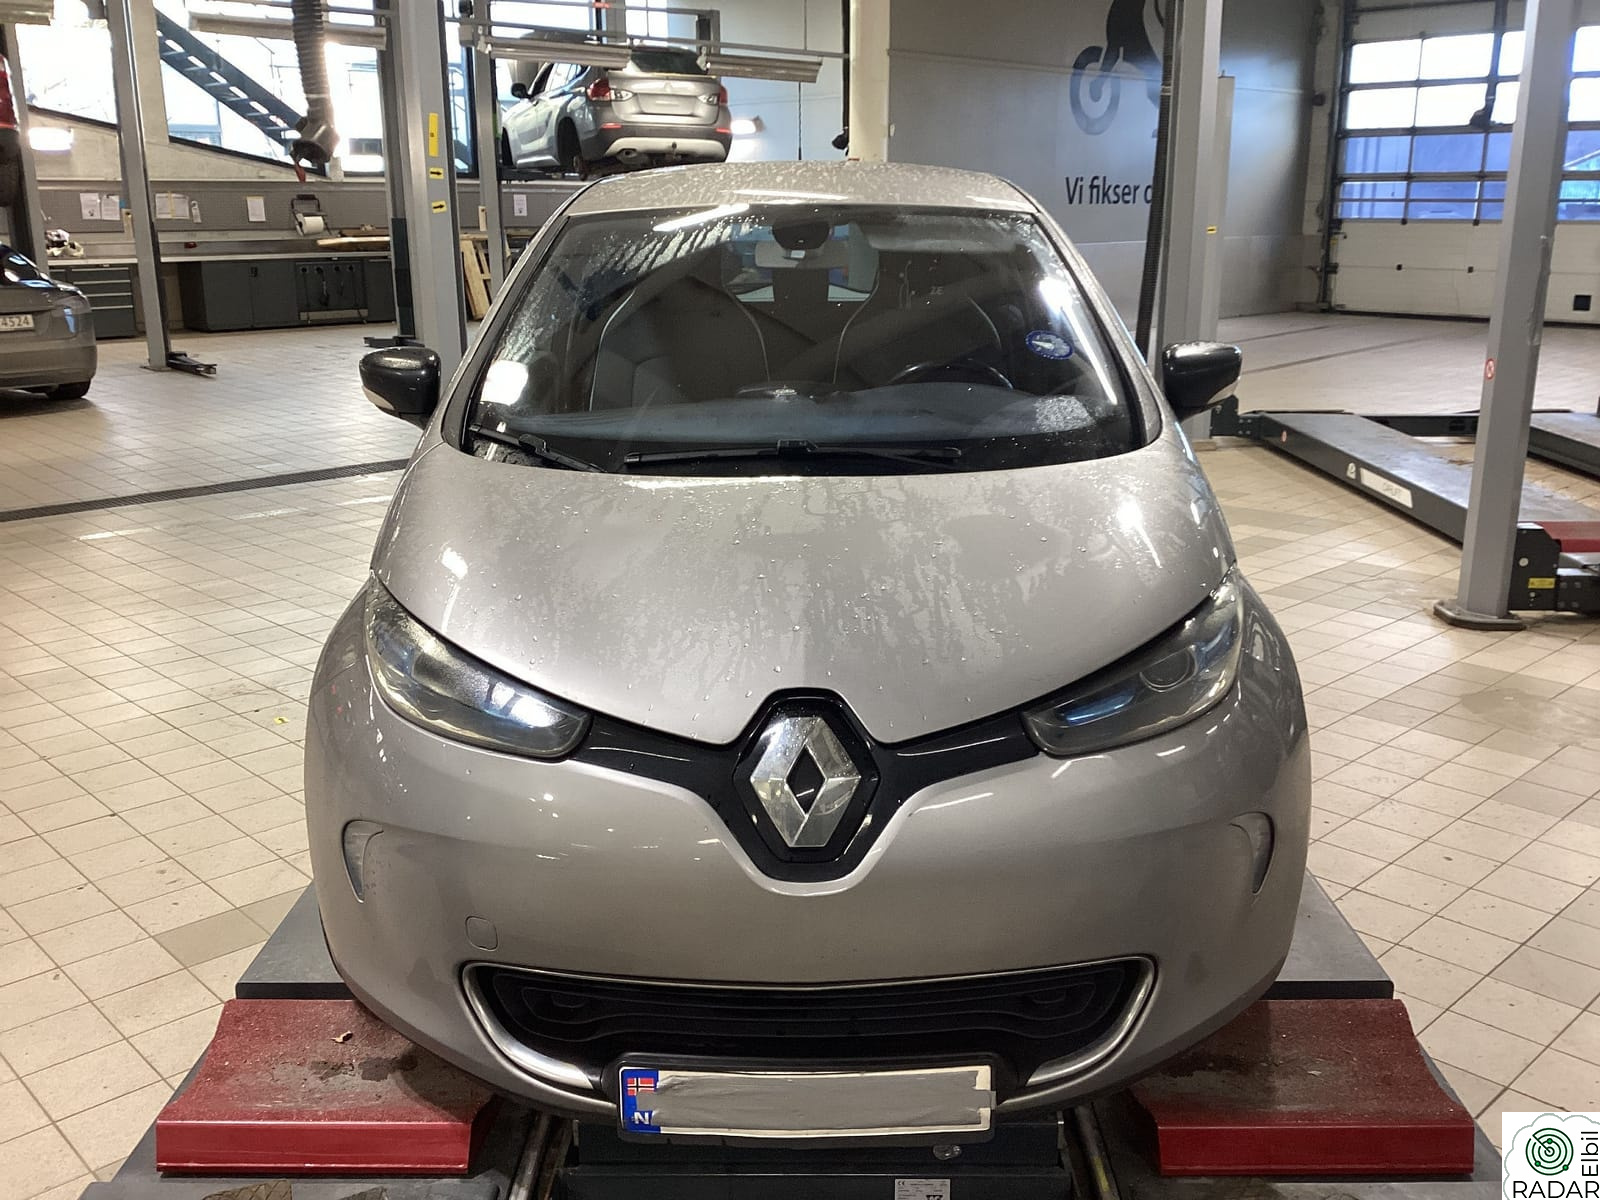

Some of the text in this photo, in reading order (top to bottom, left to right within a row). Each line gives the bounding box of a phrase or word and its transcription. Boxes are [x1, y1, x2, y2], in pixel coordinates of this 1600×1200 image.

[1065, 176, 1083, 204] Vi
[1089, 176, 1140, 204] fikser
[634, 1111, 649, 1124] N
